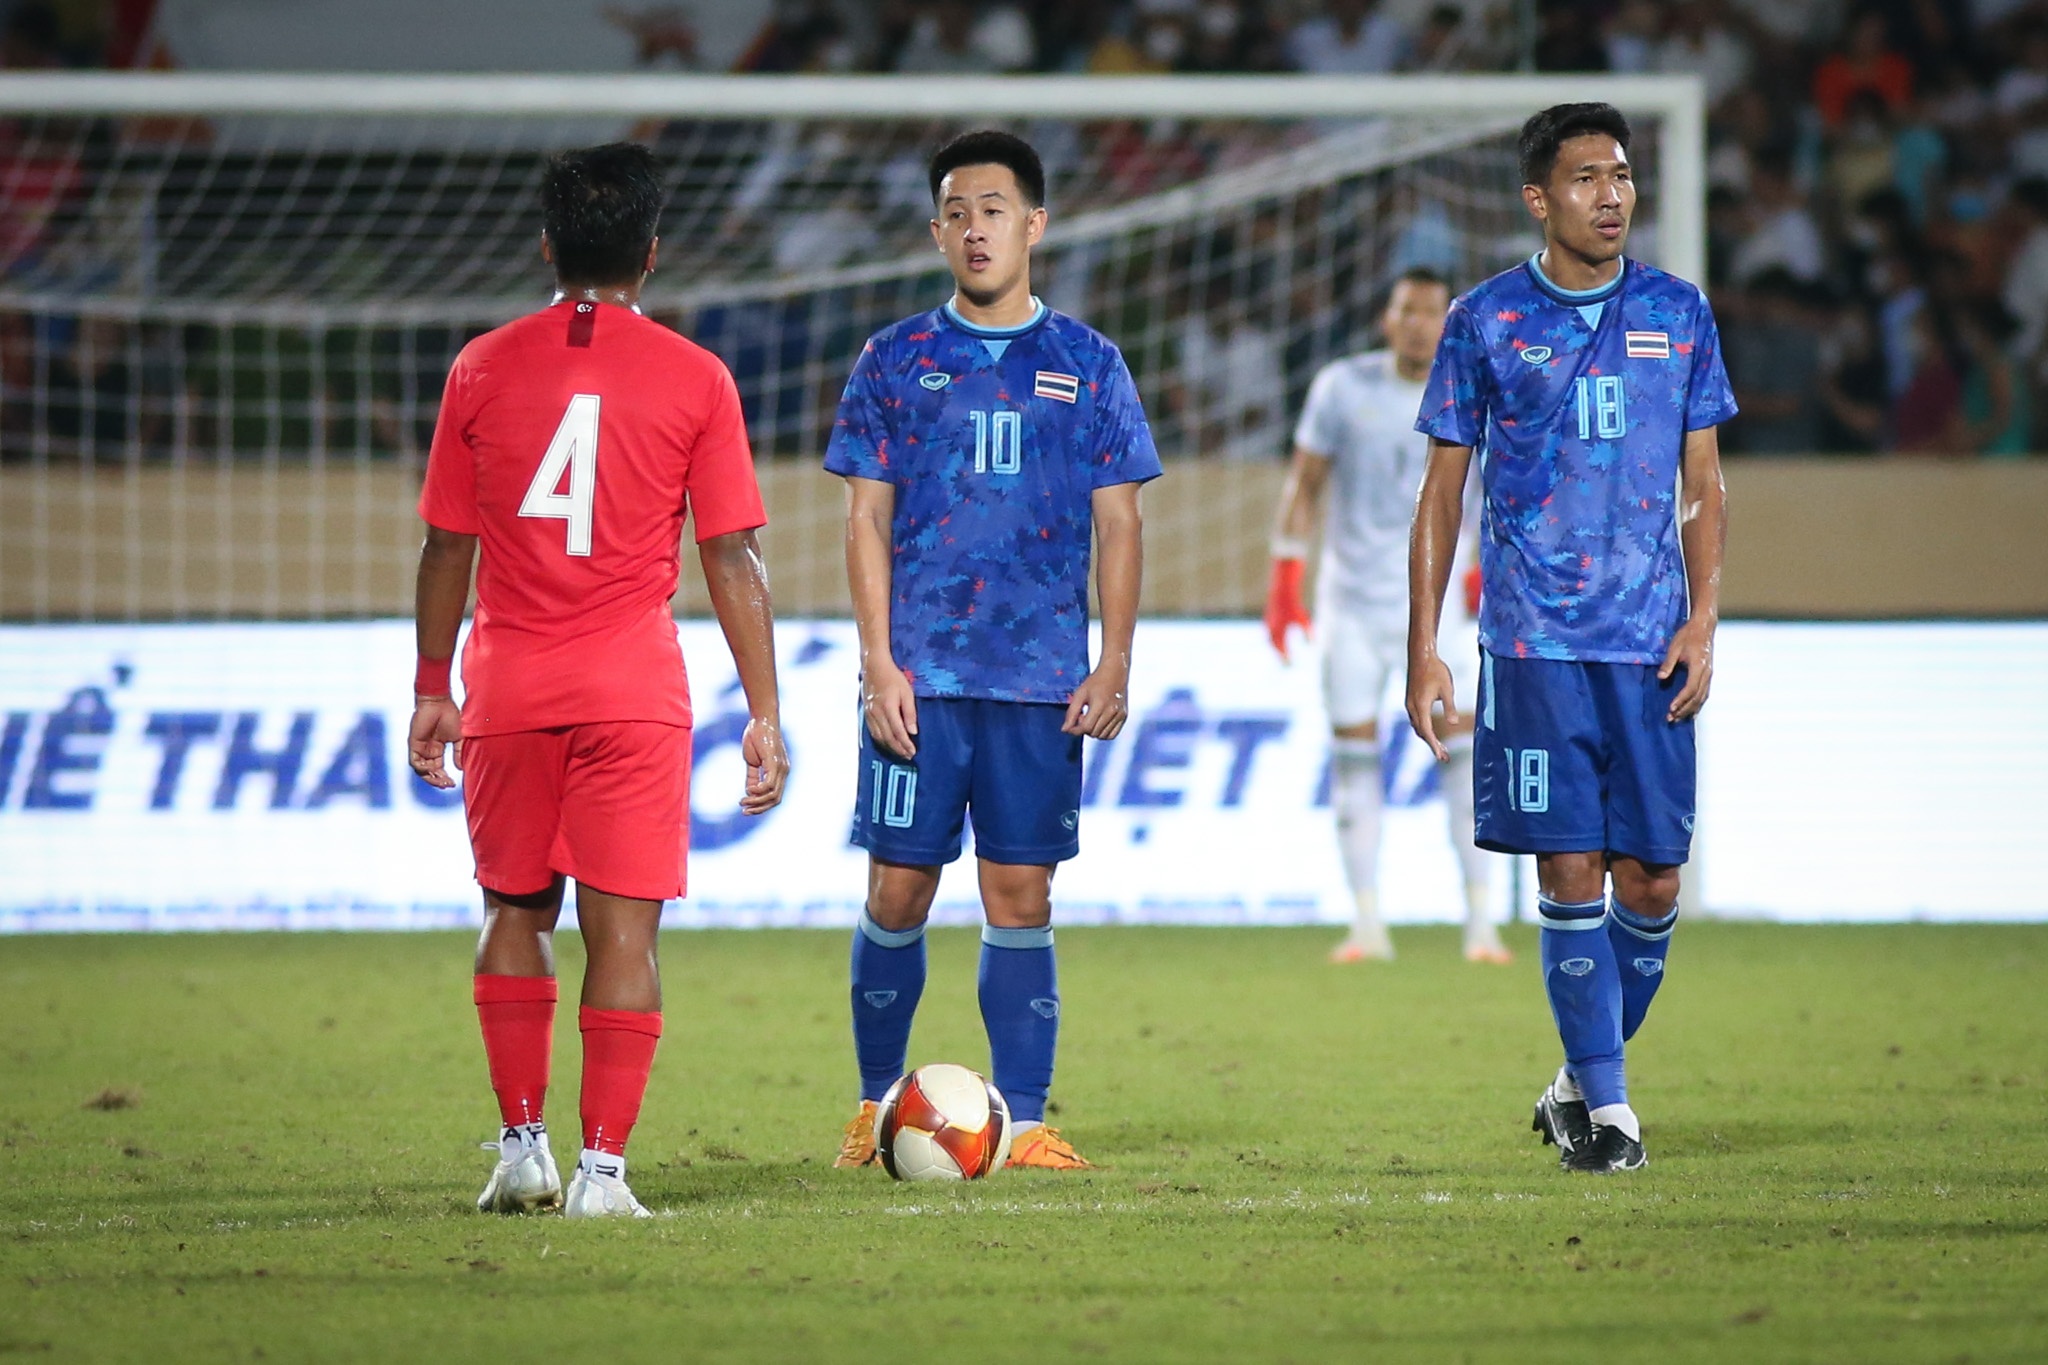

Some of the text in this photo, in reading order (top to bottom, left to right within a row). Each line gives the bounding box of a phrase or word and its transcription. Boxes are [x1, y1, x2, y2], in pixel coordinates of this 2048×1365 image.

[1576, 375, 1627, 440] 18
[517, 393, 602, 557] 4
[969, 410, 1022, 475] 10
[871, 759, 918, 829] 10
[1503, 747, 1550, 814] 18
